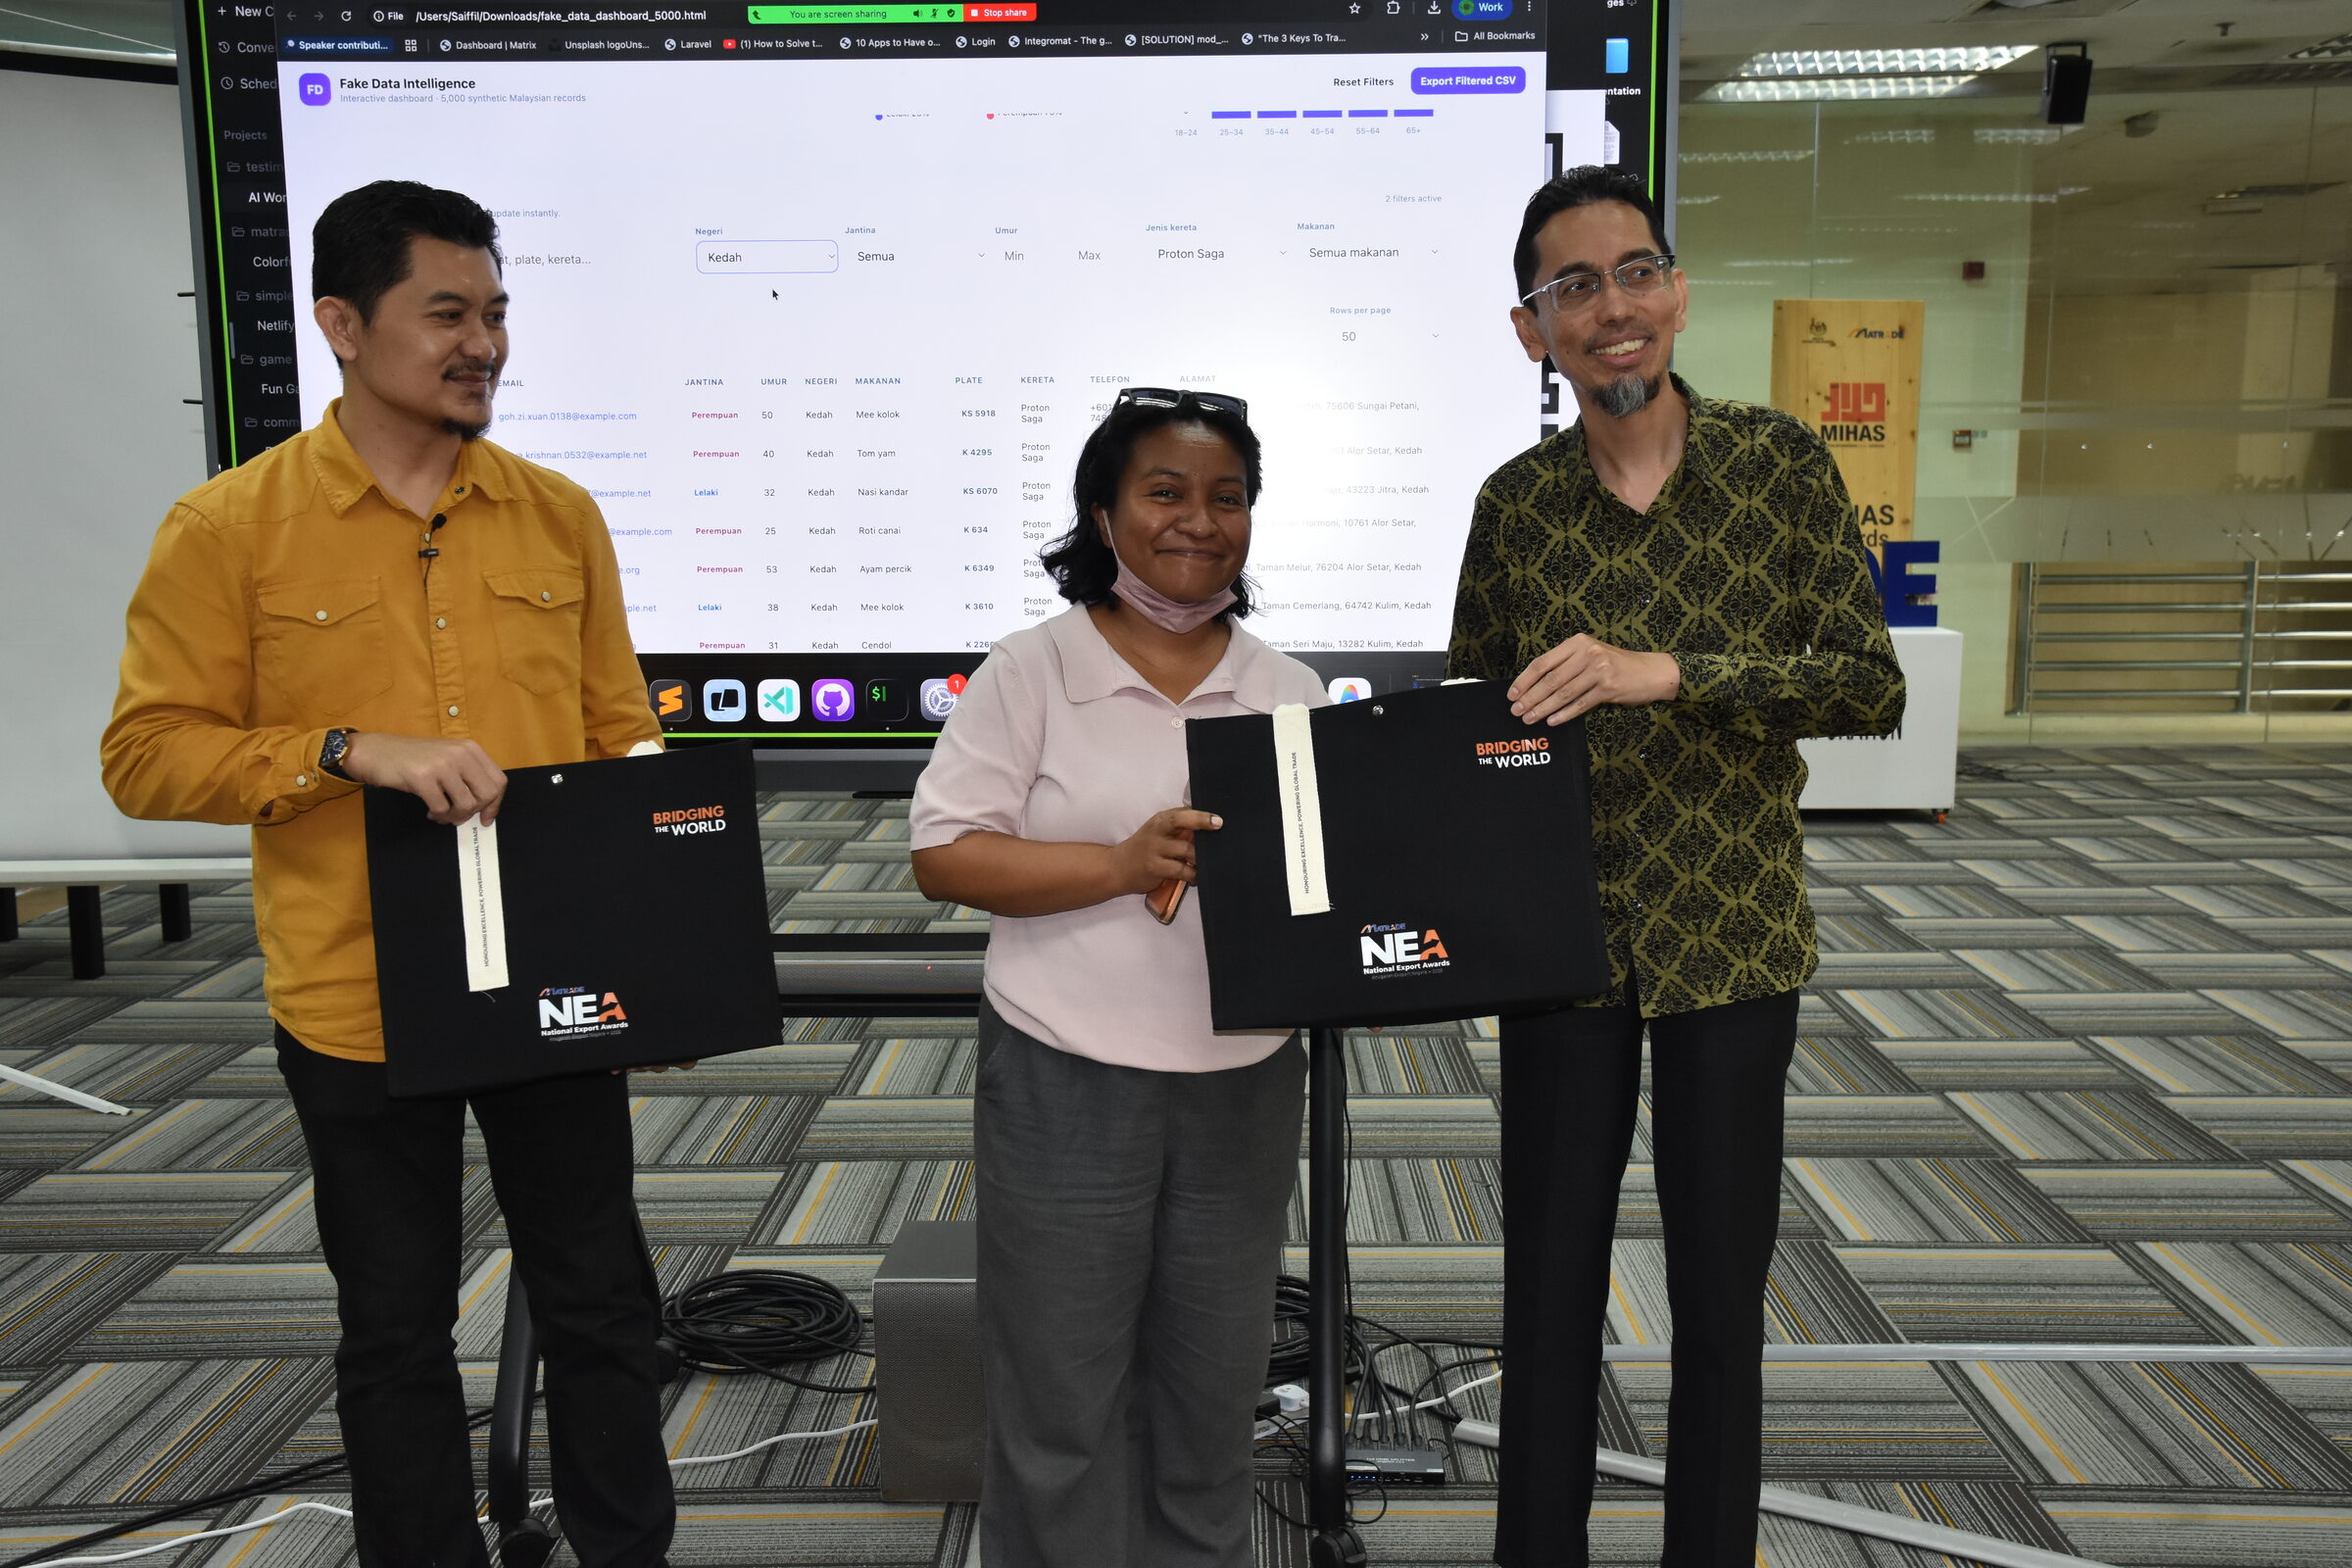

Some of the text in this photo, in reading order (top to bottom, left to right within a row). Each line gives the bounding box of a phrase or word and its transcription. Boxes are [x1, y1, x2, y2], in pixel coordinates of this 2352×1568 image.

[234, 5, 263, 18] New
[1478, 2, 1503, 12] Work
[387, 11, 405, 22] File
[789, 10, 808, 19] You
[855, 9, 888, 20] sharing
[983, 8, 1028, 19] Stop share
[1141, 34, 1195, 46] [SOLUTION]
[1281, 33, 1288, 43] 3
[1289, 33, 1311, 44] Keys
[1312, 33, 1324, 42] To
[1473, 30, 1536, 40] All Bookmarks
[298, 40, 336, 51] Speaker
[456, 40, 537, 50] Dashboard Matrix
[564, 40, 606, 51] Unsplash
[680, 39, 712, 49] Laravel
[740, 38, 810, 50] (1) How to Solve
[856, 38, 926, 49] 10 Apps to Have
[971, 37, 997, 48] Login
[1024, 35, 1098, 47] Integromat The
[339, 77, 476, 92] Fake Data Intelligence
[1333, 76, 1395, 87] Reset Filters
[1420, 75, 1517, 88] Export Filtered CSV
[307, 84, 324, 95] FD
[340, 93, 587, 104] Interactive dashboard 5,000 synthetic Malaysian records
[1404, 125, 1422, 134] 65+
[223, 129, 268, 142] Projects
[248, 191, 261, 203] AI
[1385, 194, 1443, 204] 2 filters active
[492, 208, 521, 220] update
[695, 226, 723, 237] Negeri
[844, 225, 876, 234] Jantina
[1145, 223, 1168, 232] Jenis
[708, 252, 743, 263] Kedah
[858, 251, 895, 262] Semua
[1004, 250, 1025, 262] Min
[1078, 250, 1102, 261] Max
[1157, 248, 1225, 261] Proton Saga
[1308, 246, 1399, 259] Semua makanan
[514, 254, 545, 267] plate,
[1329, 306, 1353, 315] Rows
[257, 319, 294, 333] Netlify
[1342, 330, 1356, 342] 50
[259, 356, 293, 368] game
[497, 379, 525, 388] EMAIL
[760, 377, 788, 386] UMUR
[1020, 375, 1055, 384] KERETA
[1090, 375, 1130, 384] TELEFON
[1179, 374, 1216, 383] ALAMAT
[261, 383, 283, 395] Fun
[1020, 403, 1051, 413] Proton
[691, 412, 739, 420] Perempuan
[761, 411, 773, 419] 50
[806, 411, 833, 419] Kedah
[856, 410, 901, 419] Mee kolok
[1020, 415, 1044, 424] Saga
[1820, 424, 1886, 442] MIHAS
[694, 488, 718, 497] Lelaki
[763, 488, 775, 497] 32
[808, 488, 835, 497] Kedah
[858, 487, 877, 497] Nasi
[1262, 601, 1432, 612] Taman Cemerlang, 64742 Kulim, Kedah
[699, 642, 746, 651] Perempuan
[768, 641, 778, 650] 31
[811, 641, 839, 650] Kedah
[860, 641, 892, 650] Cendol
[1293, 639, 1424, 650] Seri Maju, 13282 Kulim, Kedah
[954, 679, 959, 689] 1
[1475, 736, 1549, 757] BRIDGING
[1478, 751, 1551, 769] THE WORLD
[652, 804, 725, 825] BRIDGING
[653, 818, 727, 837] THE WORLD
[1300, 858, 1310, 894] HONOURING
[1359, 929, 1449, 967] NEA
[1362, 965, 1396, 975] National
[1396, 962, 1421, 973] Export
[1422, 959, 1451, 969] Awards
[538, 991, 627, 1030] NEA
[540, 1027, 573, 1037] National
[573, 1024, 600, 1034] Export
[600, 1021, 629, 1031] Awards
